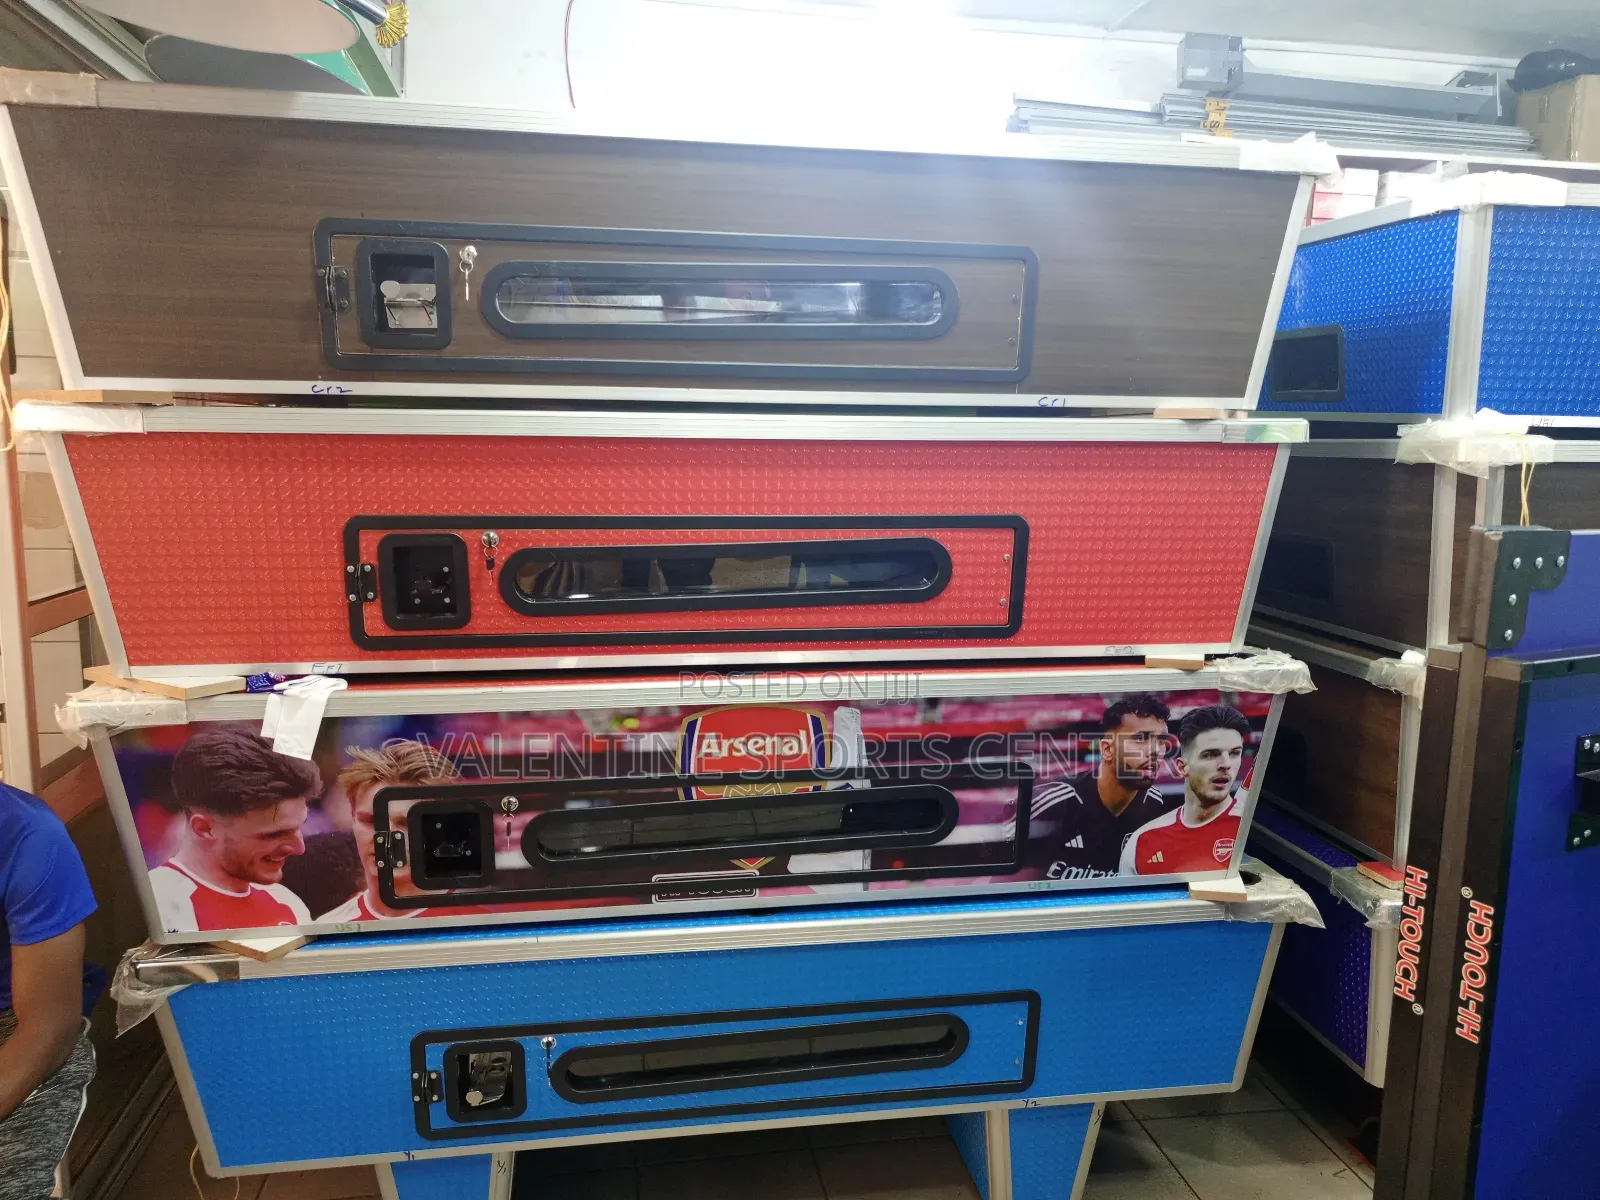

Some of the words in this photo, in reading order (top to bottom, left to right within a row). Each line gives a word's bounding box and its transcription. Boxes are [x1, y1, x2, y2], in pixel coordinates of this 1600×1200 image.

[699, 729, 809, 758] Arsenal
[1393, 865, 1428, 1002] HI-TOUCH
[1455, 899, 1494, 1044] HI-TOUCH
